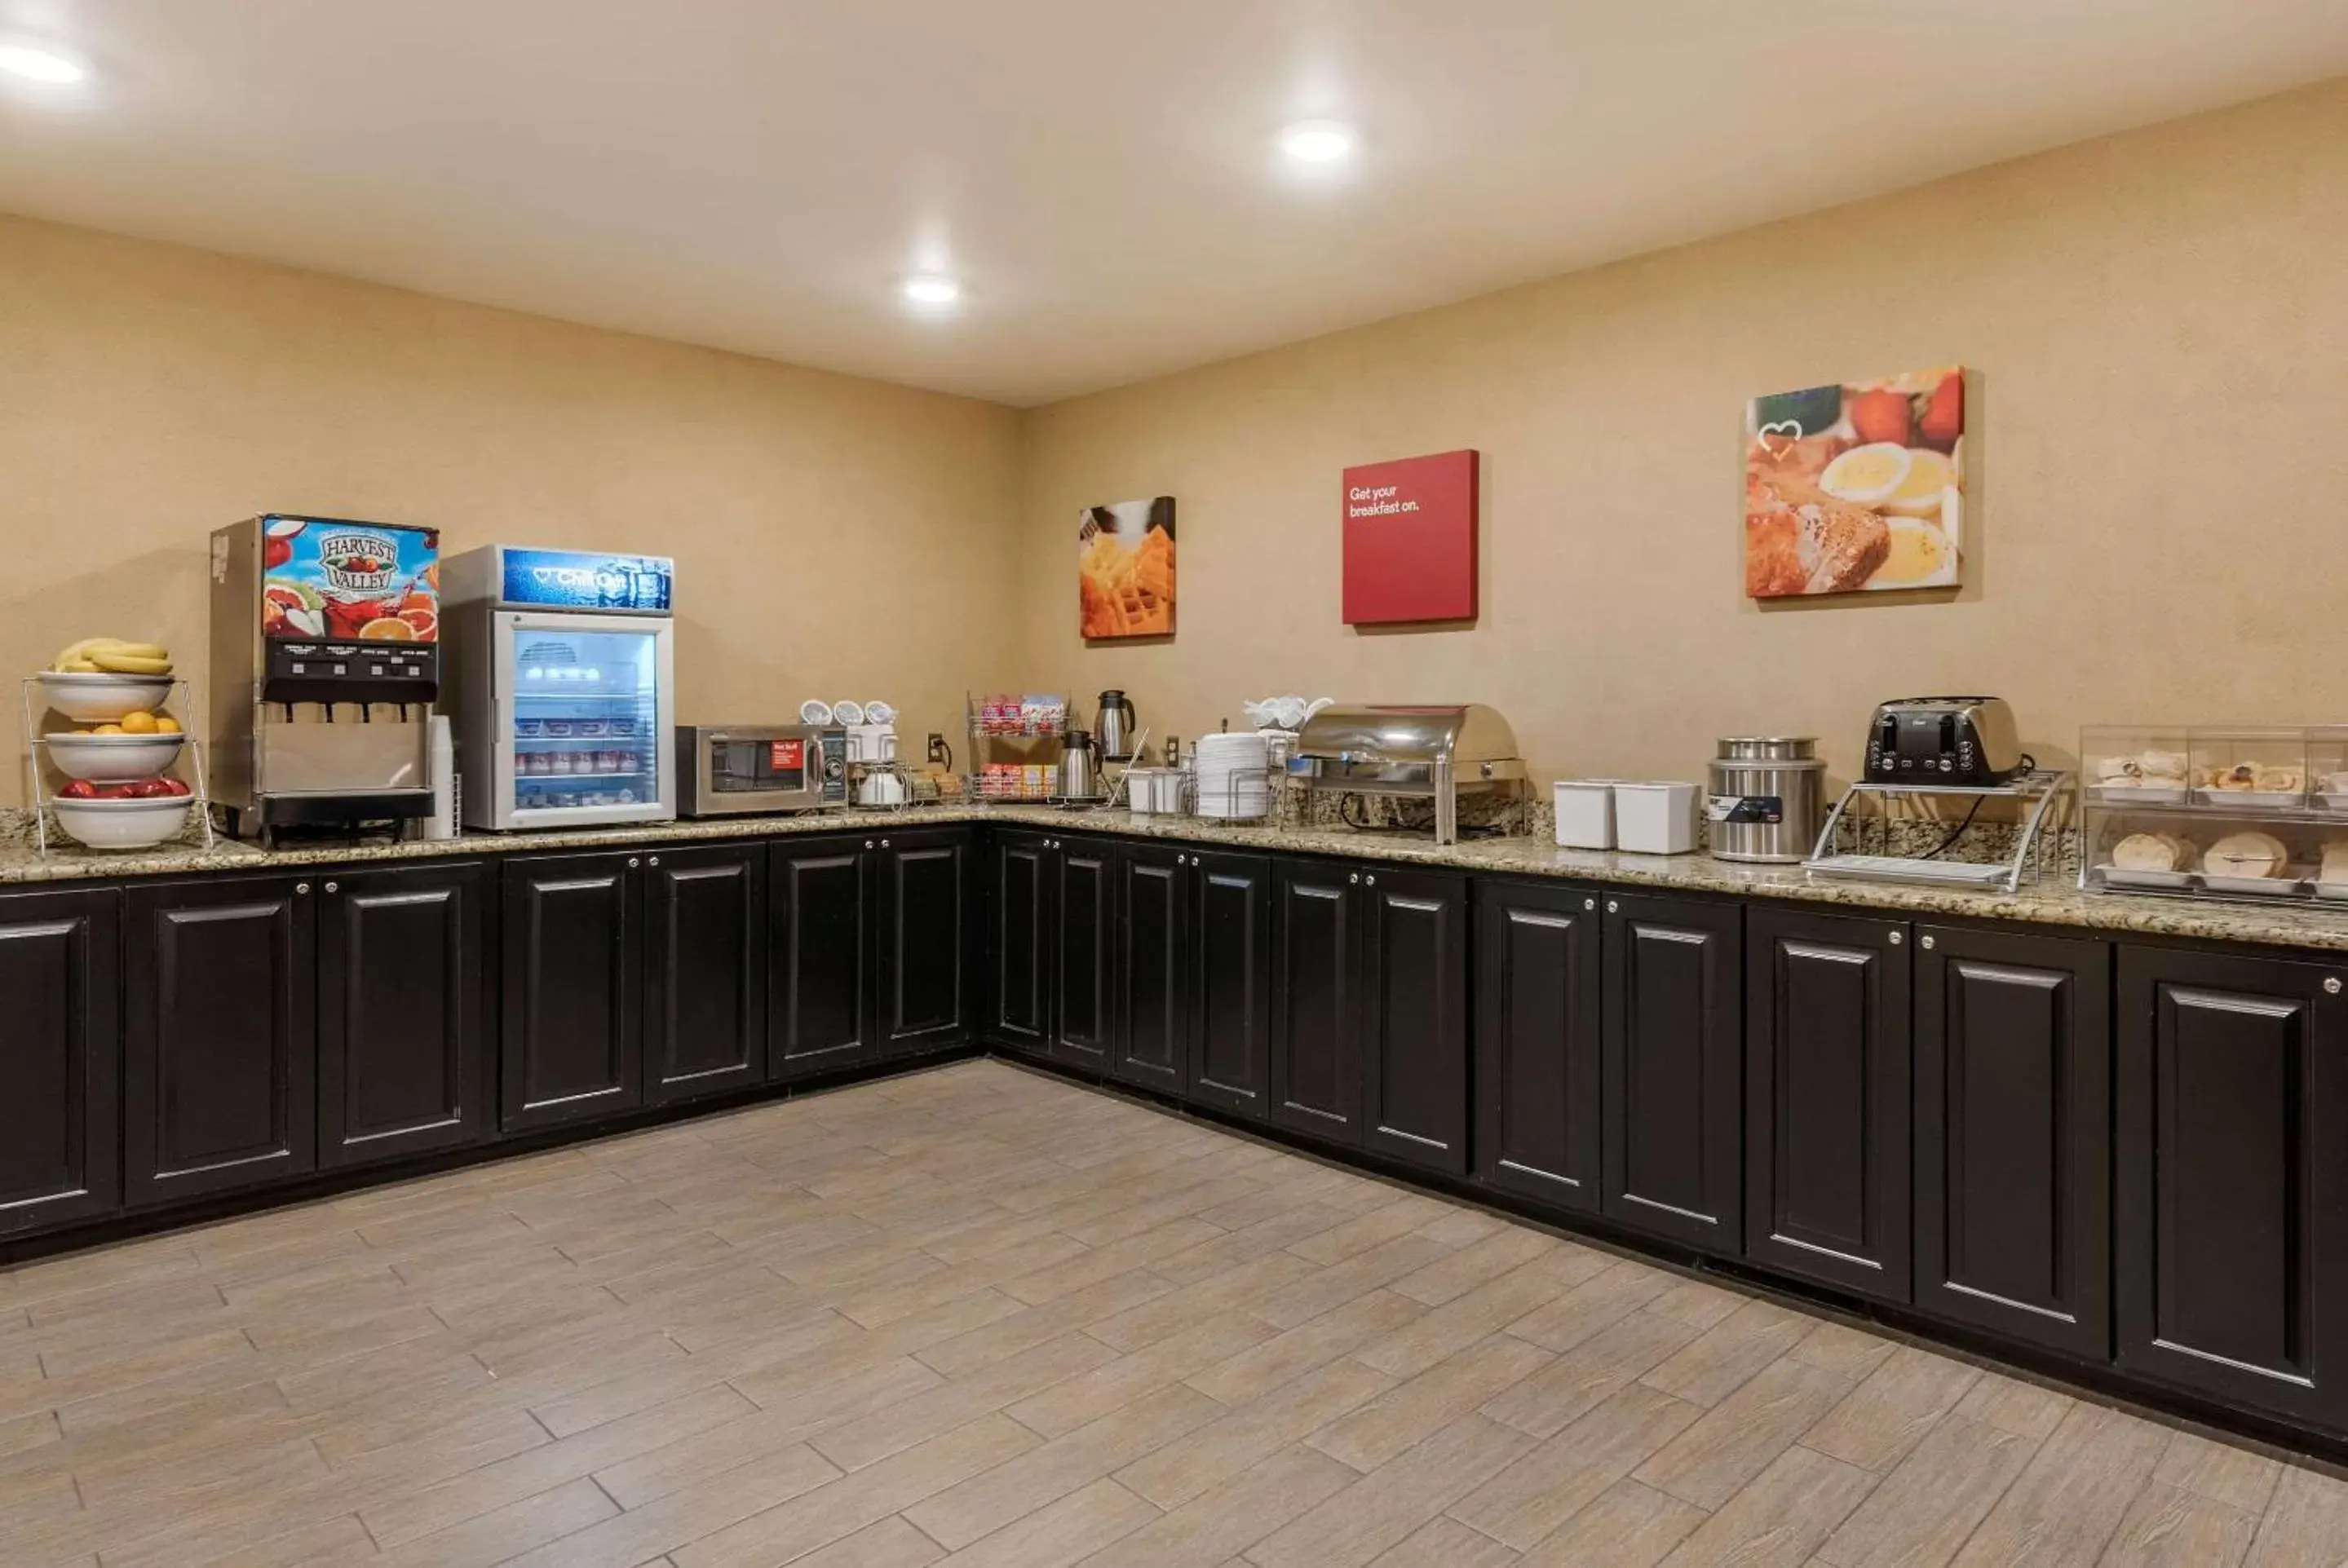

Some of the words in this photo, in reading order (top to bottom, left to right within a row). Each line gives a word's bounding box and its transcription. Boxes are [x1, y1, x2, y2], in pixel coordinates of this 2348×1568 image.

[1350, 487, 1370, 500] Get
[1372, 486, 1397, 501] your
[1350, 500, 1400, 518] breakfast
[1402, 501, 1420, 512] on.
[326, 538, 395, 561] HARVEST
[332, 569, 387, 590] VALLEY
